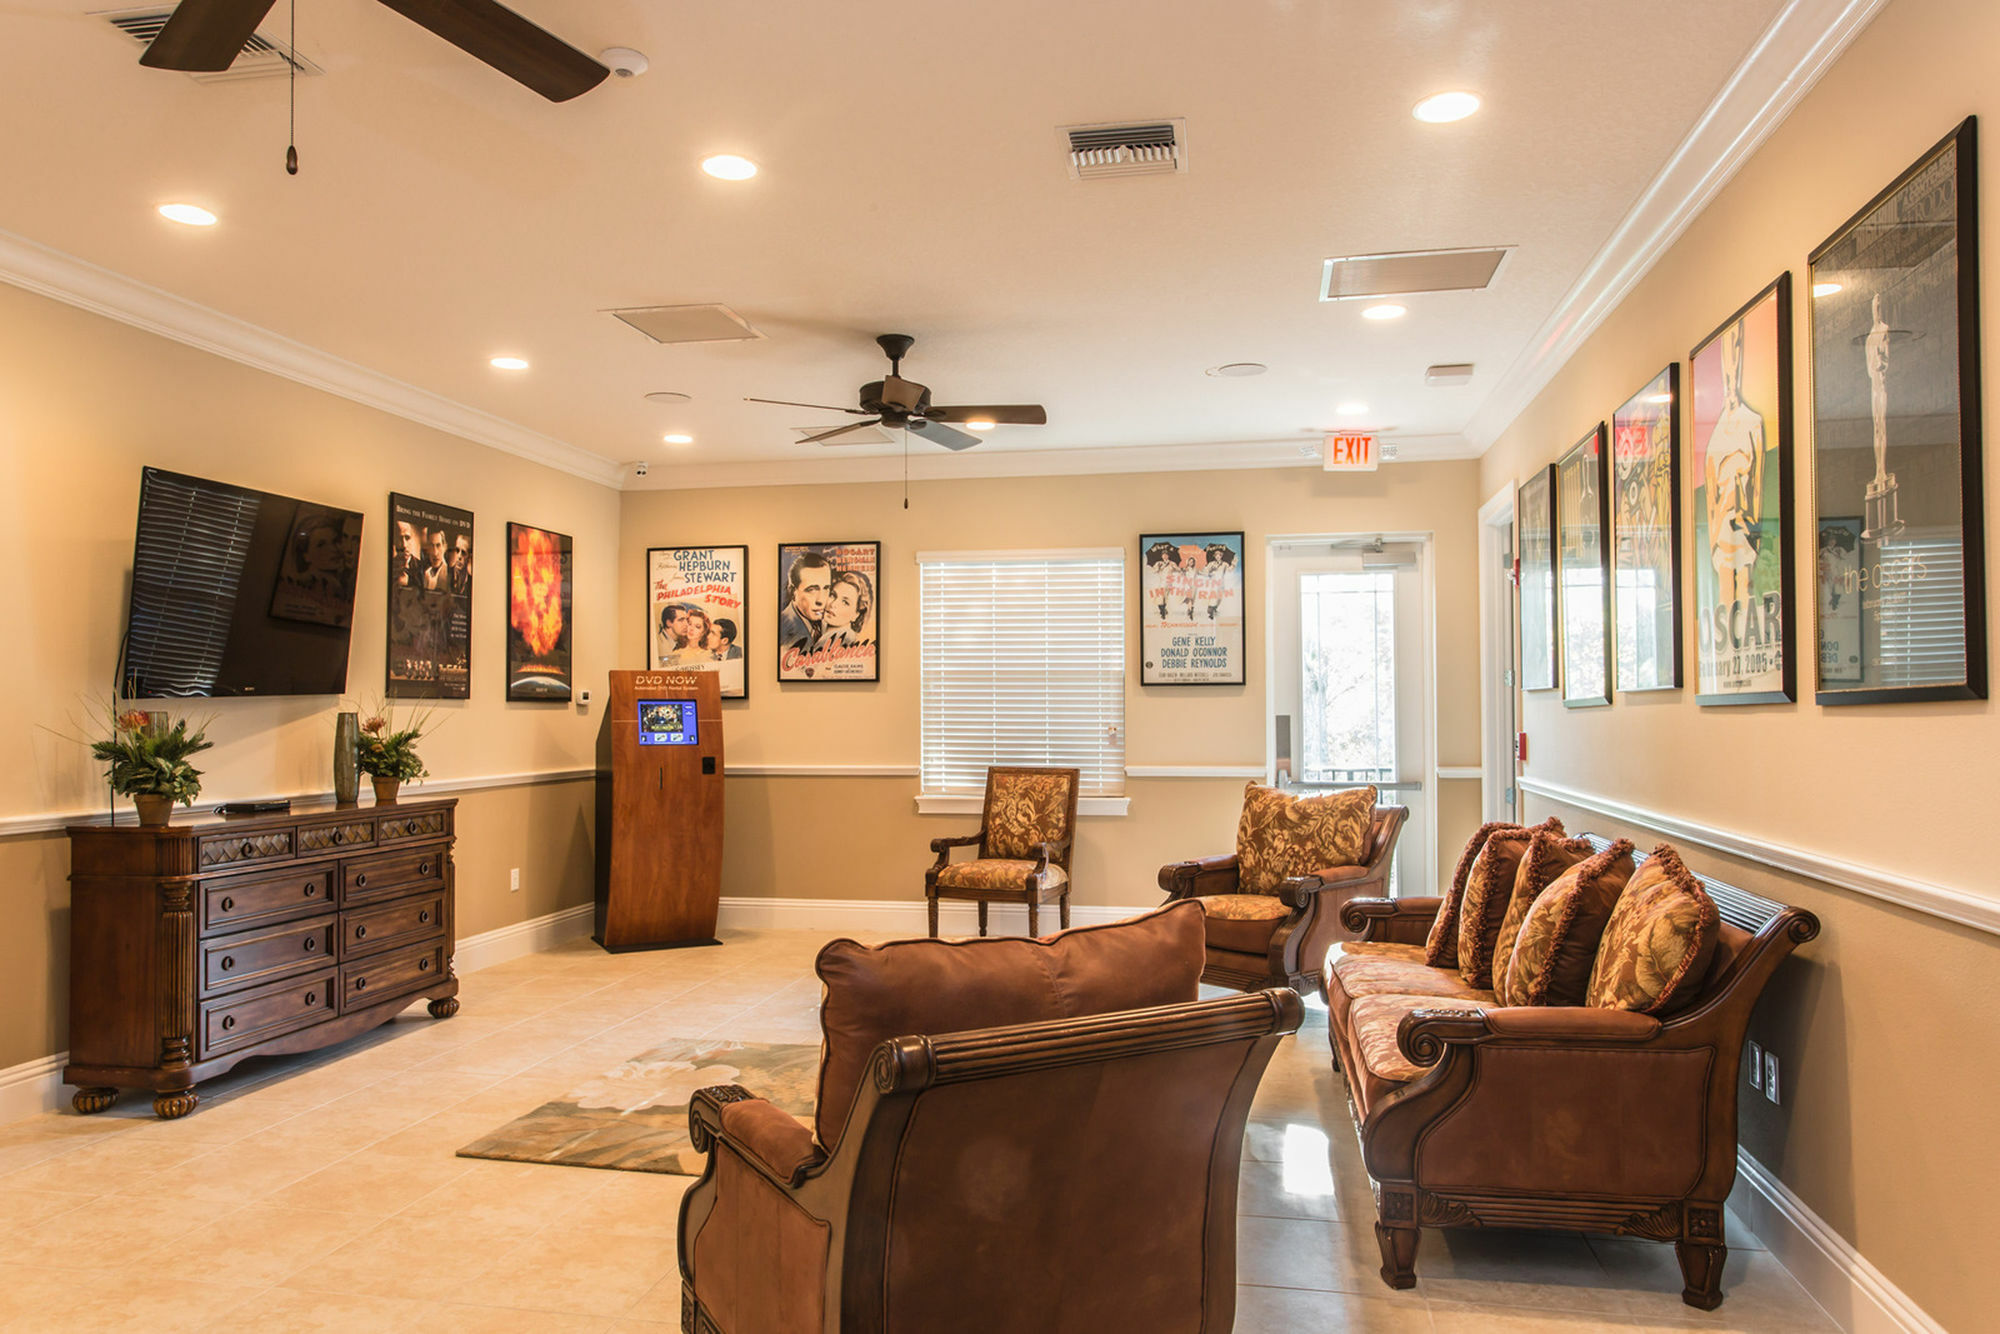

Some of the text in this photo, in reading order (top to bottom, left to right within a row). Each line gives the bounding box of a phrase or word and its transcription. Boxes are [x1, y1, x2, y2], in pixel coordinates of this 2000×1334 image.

[1333, 437, 1371, 464] EXIT
[674, 550, 714, 561] GRANT
[679, 560, 731, 571] HEPBURN
[684, 572, 736, 583] STEWART
[1844, 566, 1869, 594] the
[657, 584, 731, 600] PHILADELPHIA
[1149, 585, 1234, 600] IN THE RAIN
[704, 594, 741, 609] STORY
[1700, 592, 1781, 653] OSCAR
[1172, 637, 1216, 646] GENE KELLY
[782, 636, 876, 671] Casablanca
[1161, 647, 1227, 657] DONALD O'CONNOR
[1162, 658, 1227, 668] DEBBIE REYNOLDS
[1745, 652, 1767, 672] 2005
[635, 675, 698, 685] DVD NOW
